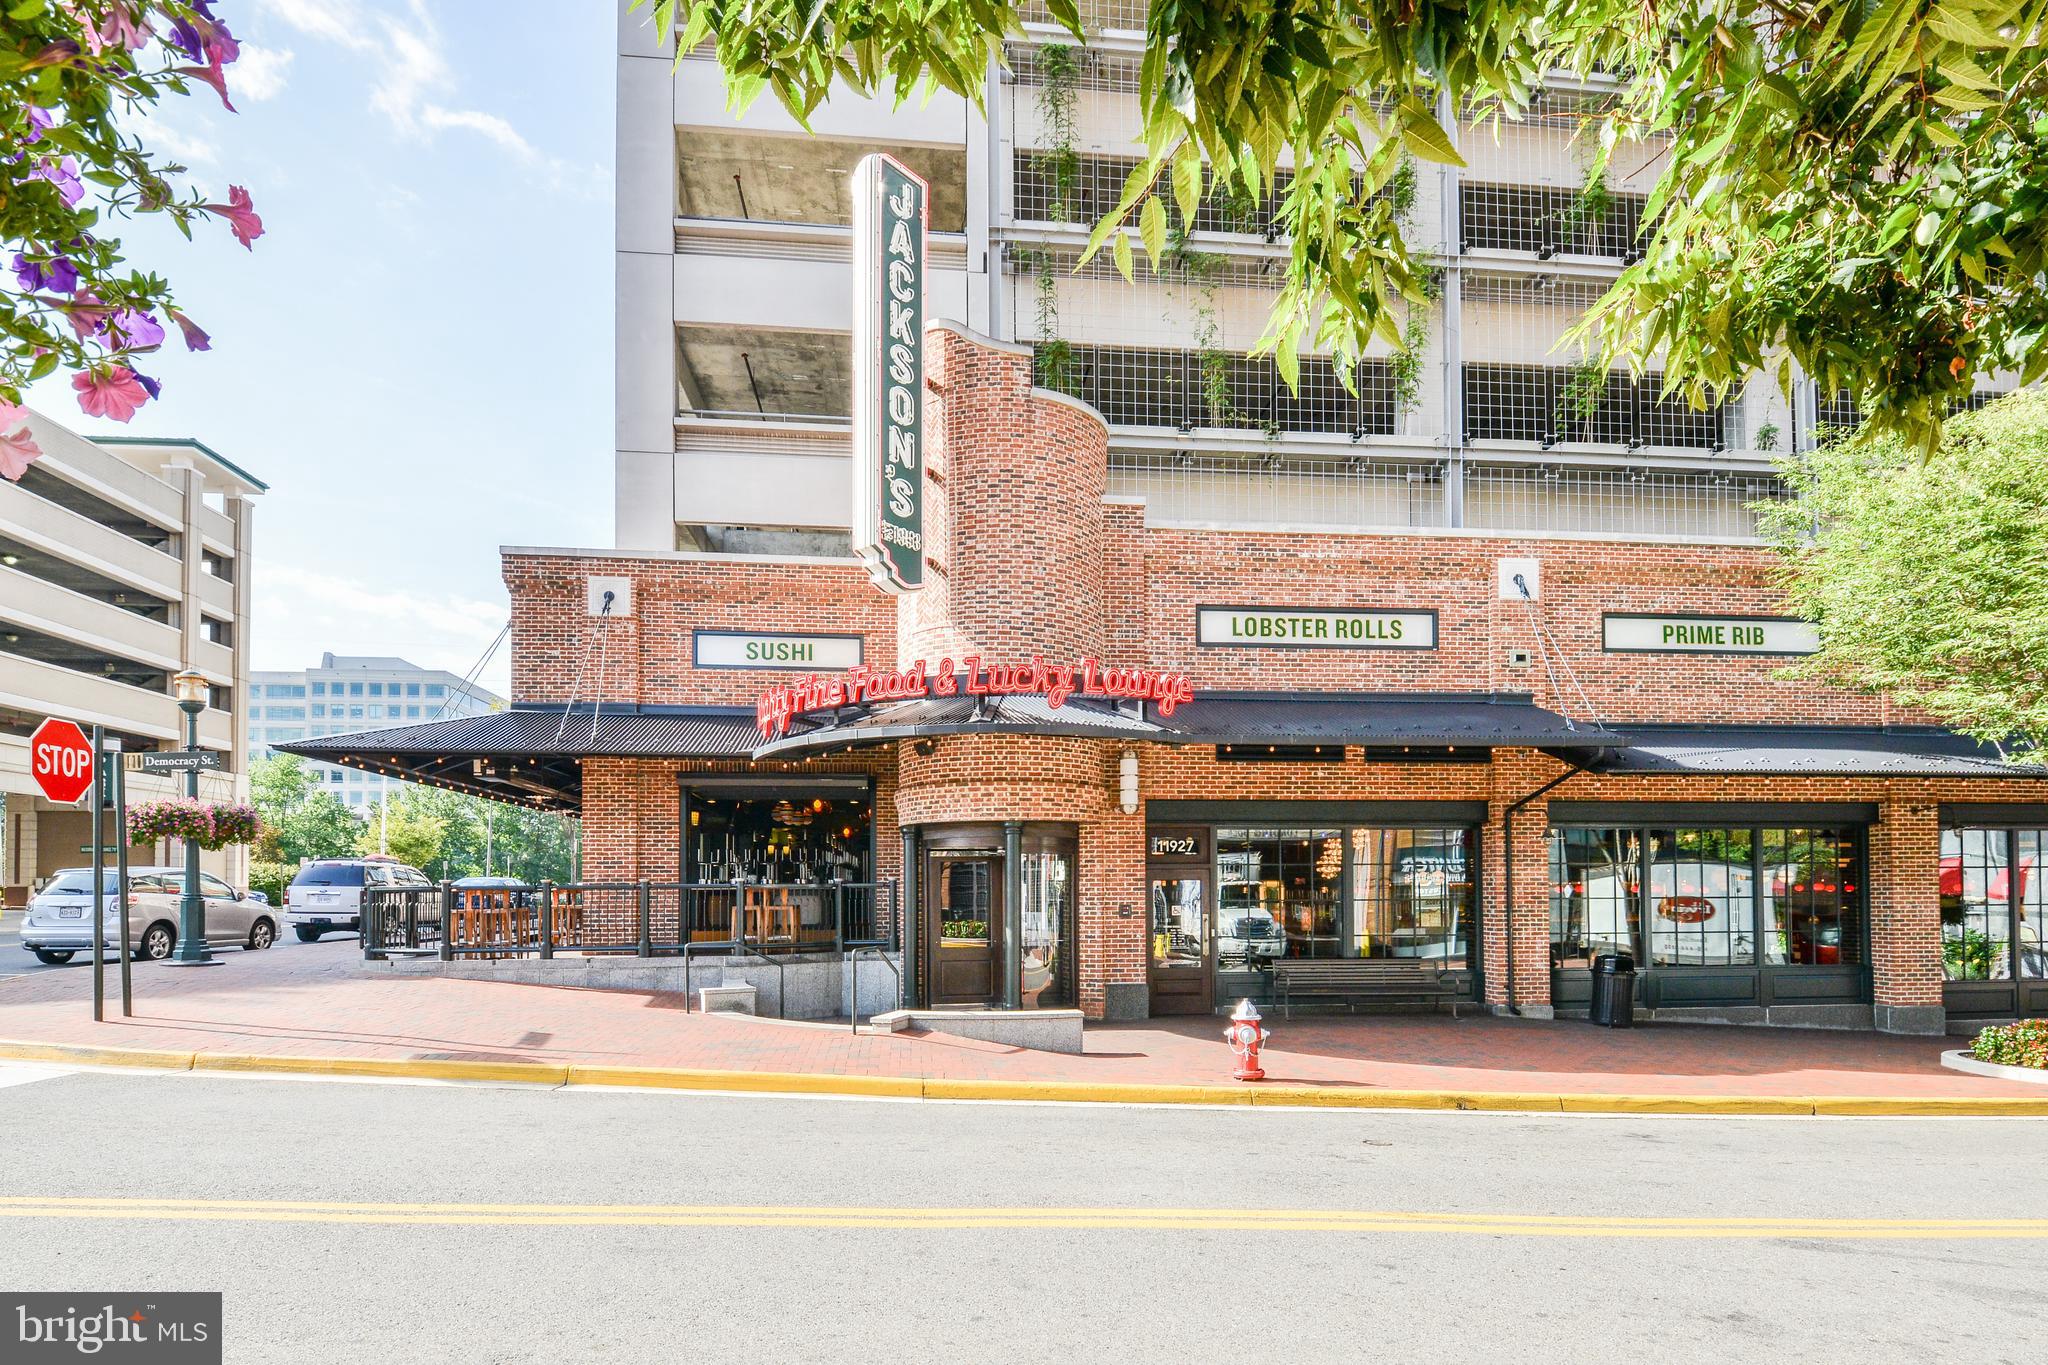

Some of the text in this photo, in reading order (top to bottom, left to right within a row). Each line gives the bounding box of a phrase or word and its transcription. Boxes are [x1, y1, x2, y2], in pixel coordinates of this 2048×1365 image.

[884, 183, 916, 518] JACKSON'S
[1232, 616, 1403, 639] LOBSTER ROLLS
[1663, 624, 1765, 645] PRIME RIB
[746, 641, 813, 661] SUSHI
[793, 673, 847, 714] Fine
[848, 663, 928, 703] Food
[933, 657, 958, 696] &
[964, 655, 1076, 710] Lucky
[1081, 656, 1195, 717] Lounge
[37, 743, 91, 779] STOP
[145, 754, 214, 768] Democracy St.
[1157, 840, 1194, 852] 11927
